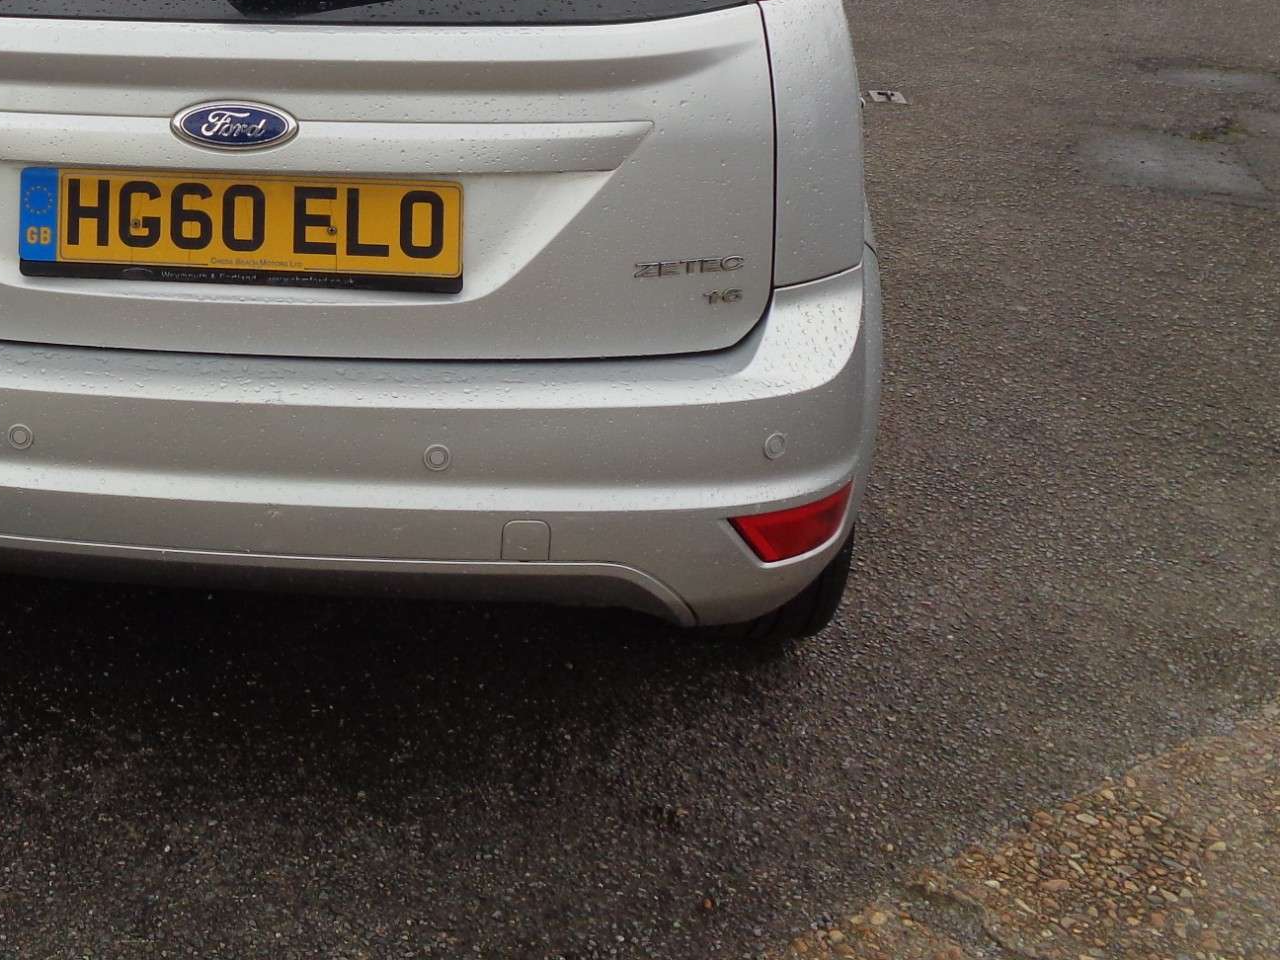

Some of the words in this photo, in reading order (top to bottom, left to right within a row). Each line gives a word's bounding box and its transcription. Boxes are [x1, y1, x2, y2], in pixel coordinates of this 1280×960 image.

[201, 110, 267, 137] Ford
[67, 178, 266, 252] HG60
[293, 186, 444, 259] ELO
[27, 226, 51, 246] GB
[634, 255, 744, 278] ZETEC
